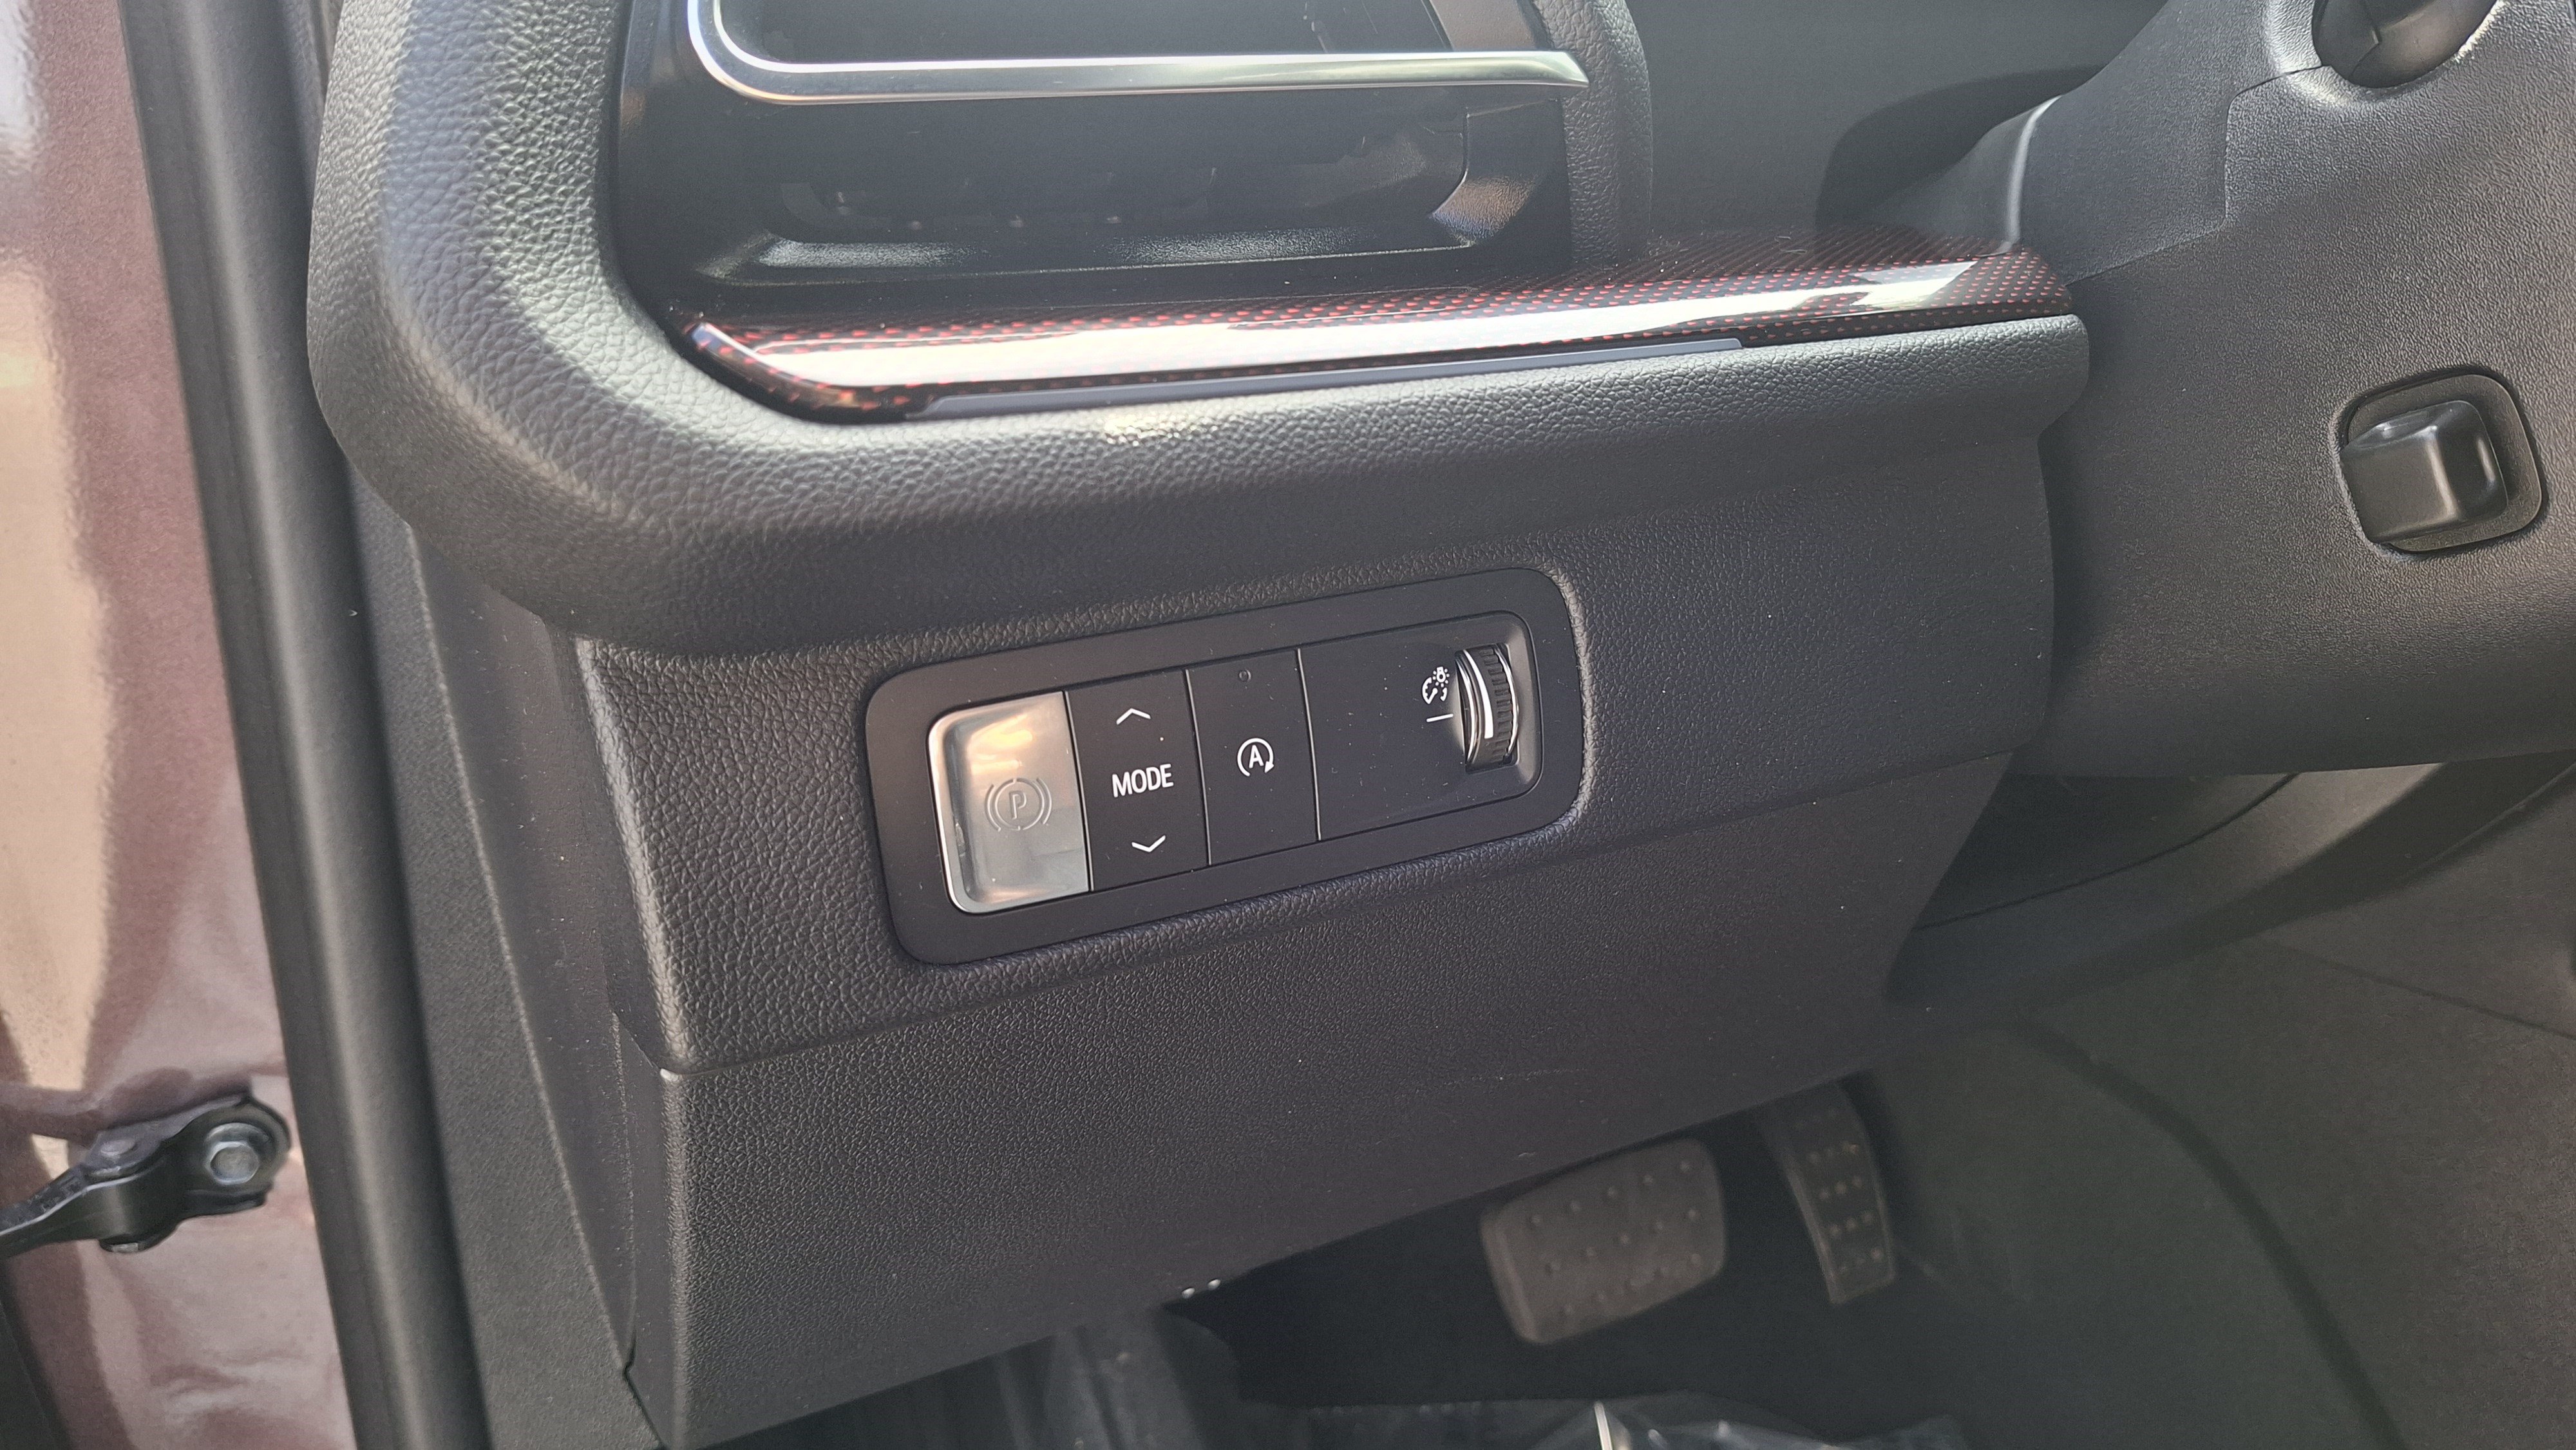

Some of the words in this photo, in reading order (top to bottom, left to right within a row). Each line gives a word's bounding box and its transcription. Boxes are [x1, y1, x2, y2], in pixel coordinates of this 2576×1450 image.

[1249, 744, 1264, 768] A
[1112, 764, 1174, 798] MODE
[1009, 790, 1027, 819] P
